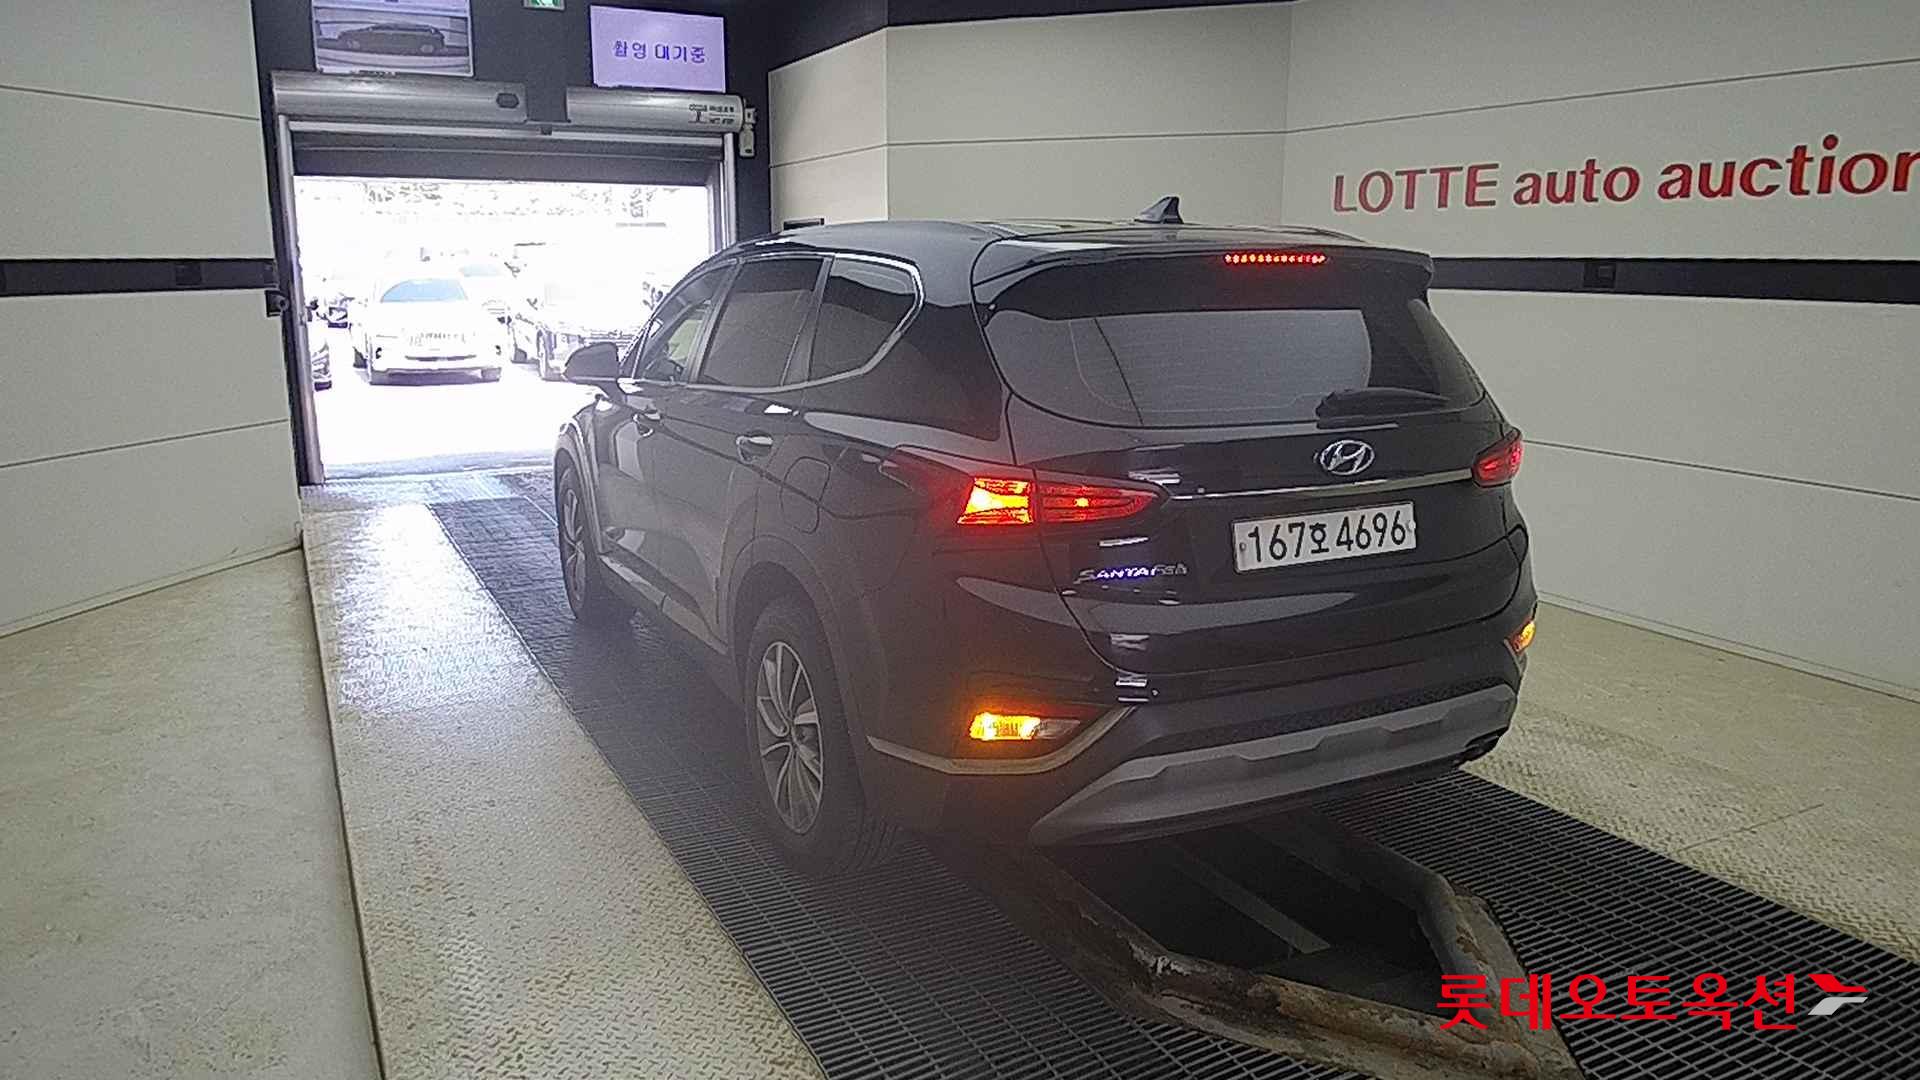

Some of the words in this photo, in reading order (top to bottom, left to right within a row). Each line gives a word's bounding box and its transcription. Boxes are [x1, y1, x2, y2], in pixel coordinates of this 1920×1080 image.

[654, 44, 706, 64] 대기중
[1334, 163, 1500, 213] LOTTE
[1514, 159, 1640, 205] auto
